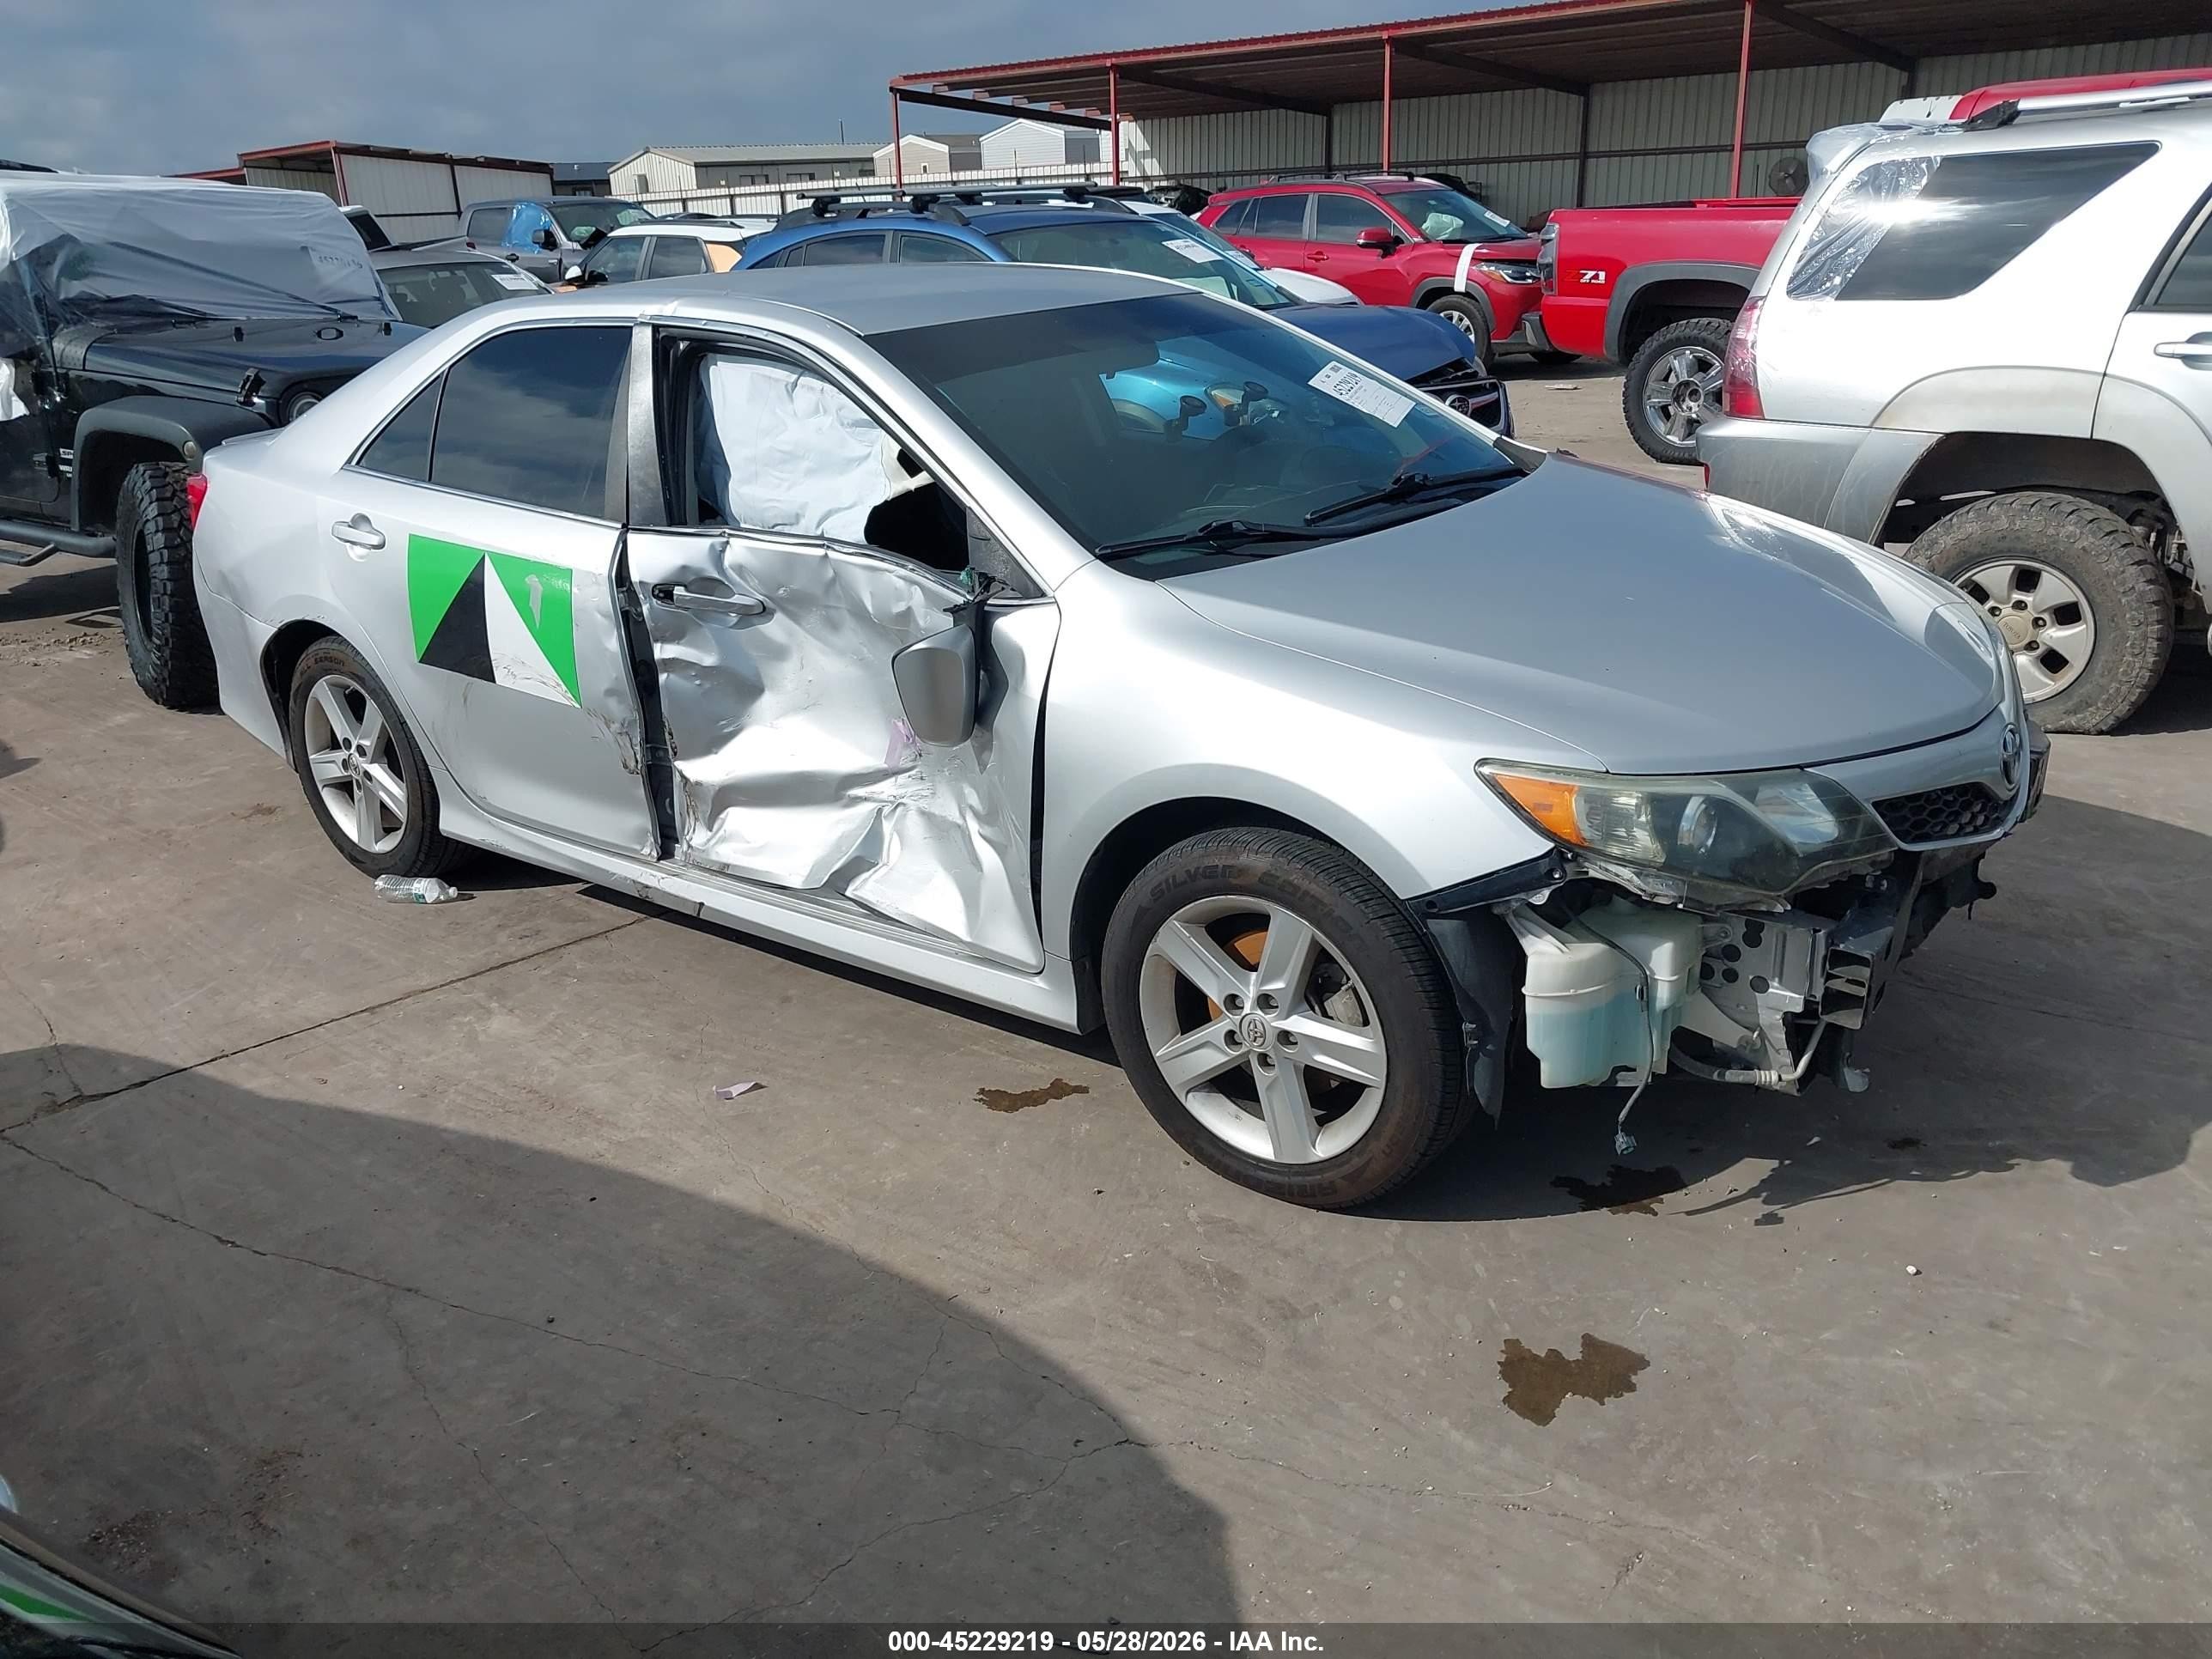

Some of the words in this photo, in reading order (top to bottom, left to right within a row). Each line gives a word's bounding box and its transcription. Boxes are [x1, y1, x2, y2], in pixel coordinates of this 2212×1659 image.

[1564, 270, 1606, 281] Z71
[1333, 372, 1362, 396] 45229219
[1150, 864, 1238, 902] SILVER
